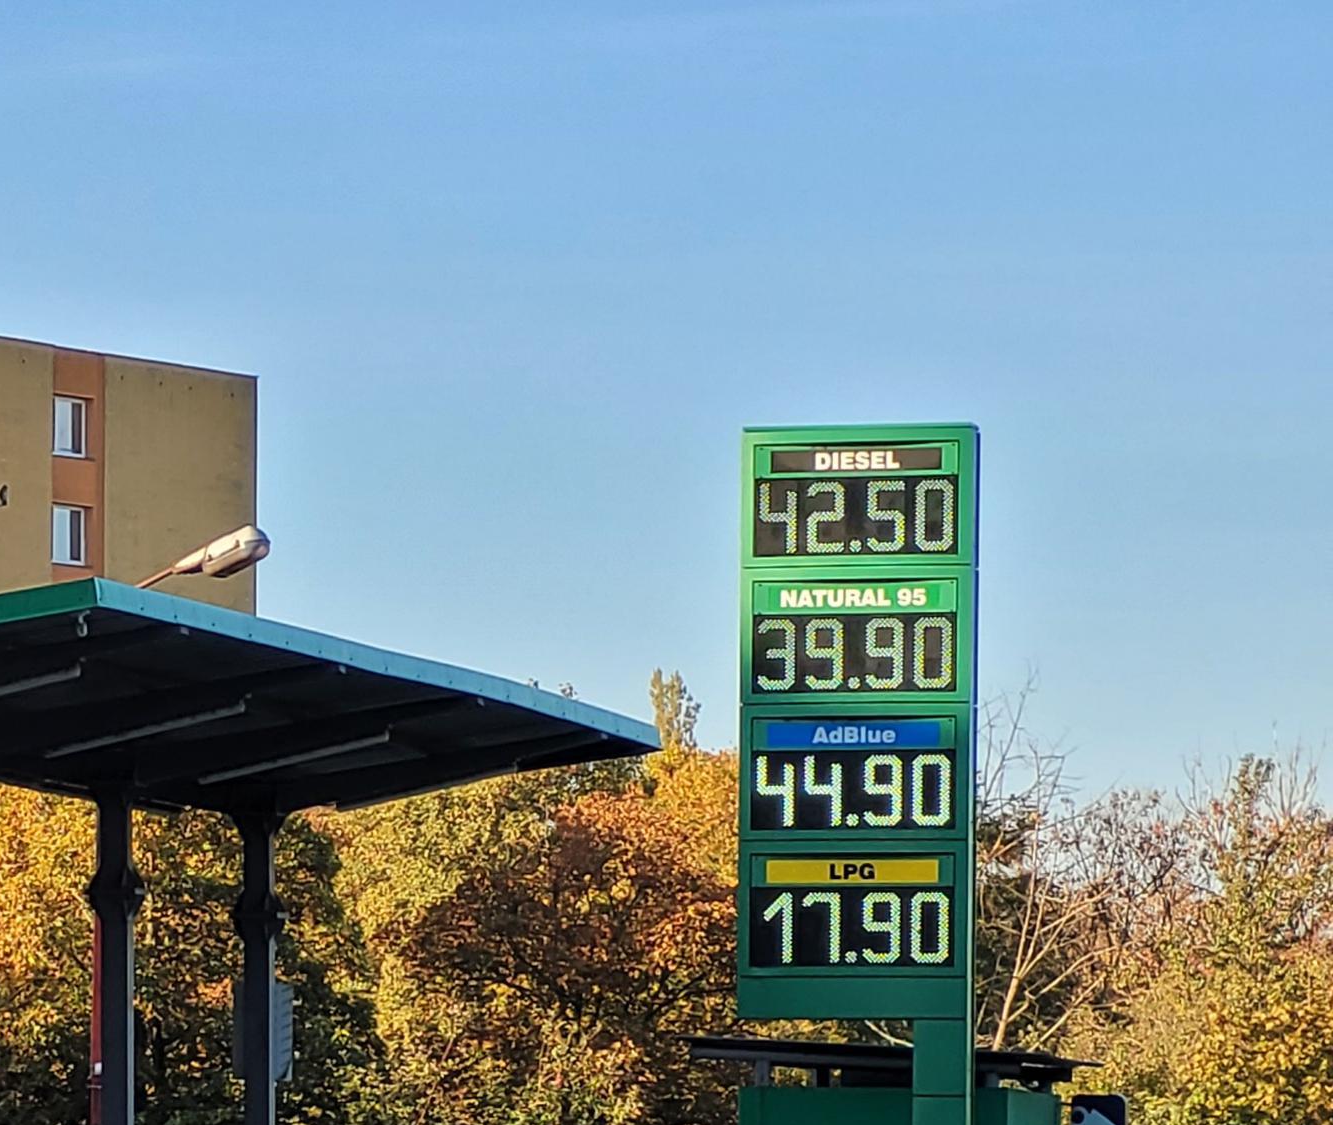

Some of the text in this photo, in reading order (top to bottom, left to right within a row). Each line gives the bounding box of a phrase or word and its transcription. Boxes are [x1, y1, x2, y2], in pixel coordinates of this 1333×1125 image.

[814, 451, 901, 471] DIESEL
[758, 479, 955, 554] 42.50
[779, 588, 927, 608] NATURAL 95
[757, 617, 953, 691] 39.90
[812, 726, 897, 744] AdBlue
[756, 754, 951, 827] 44.90
[829, 863, 876, 880] LPG
[763, 892, 950, 964] 17.90
